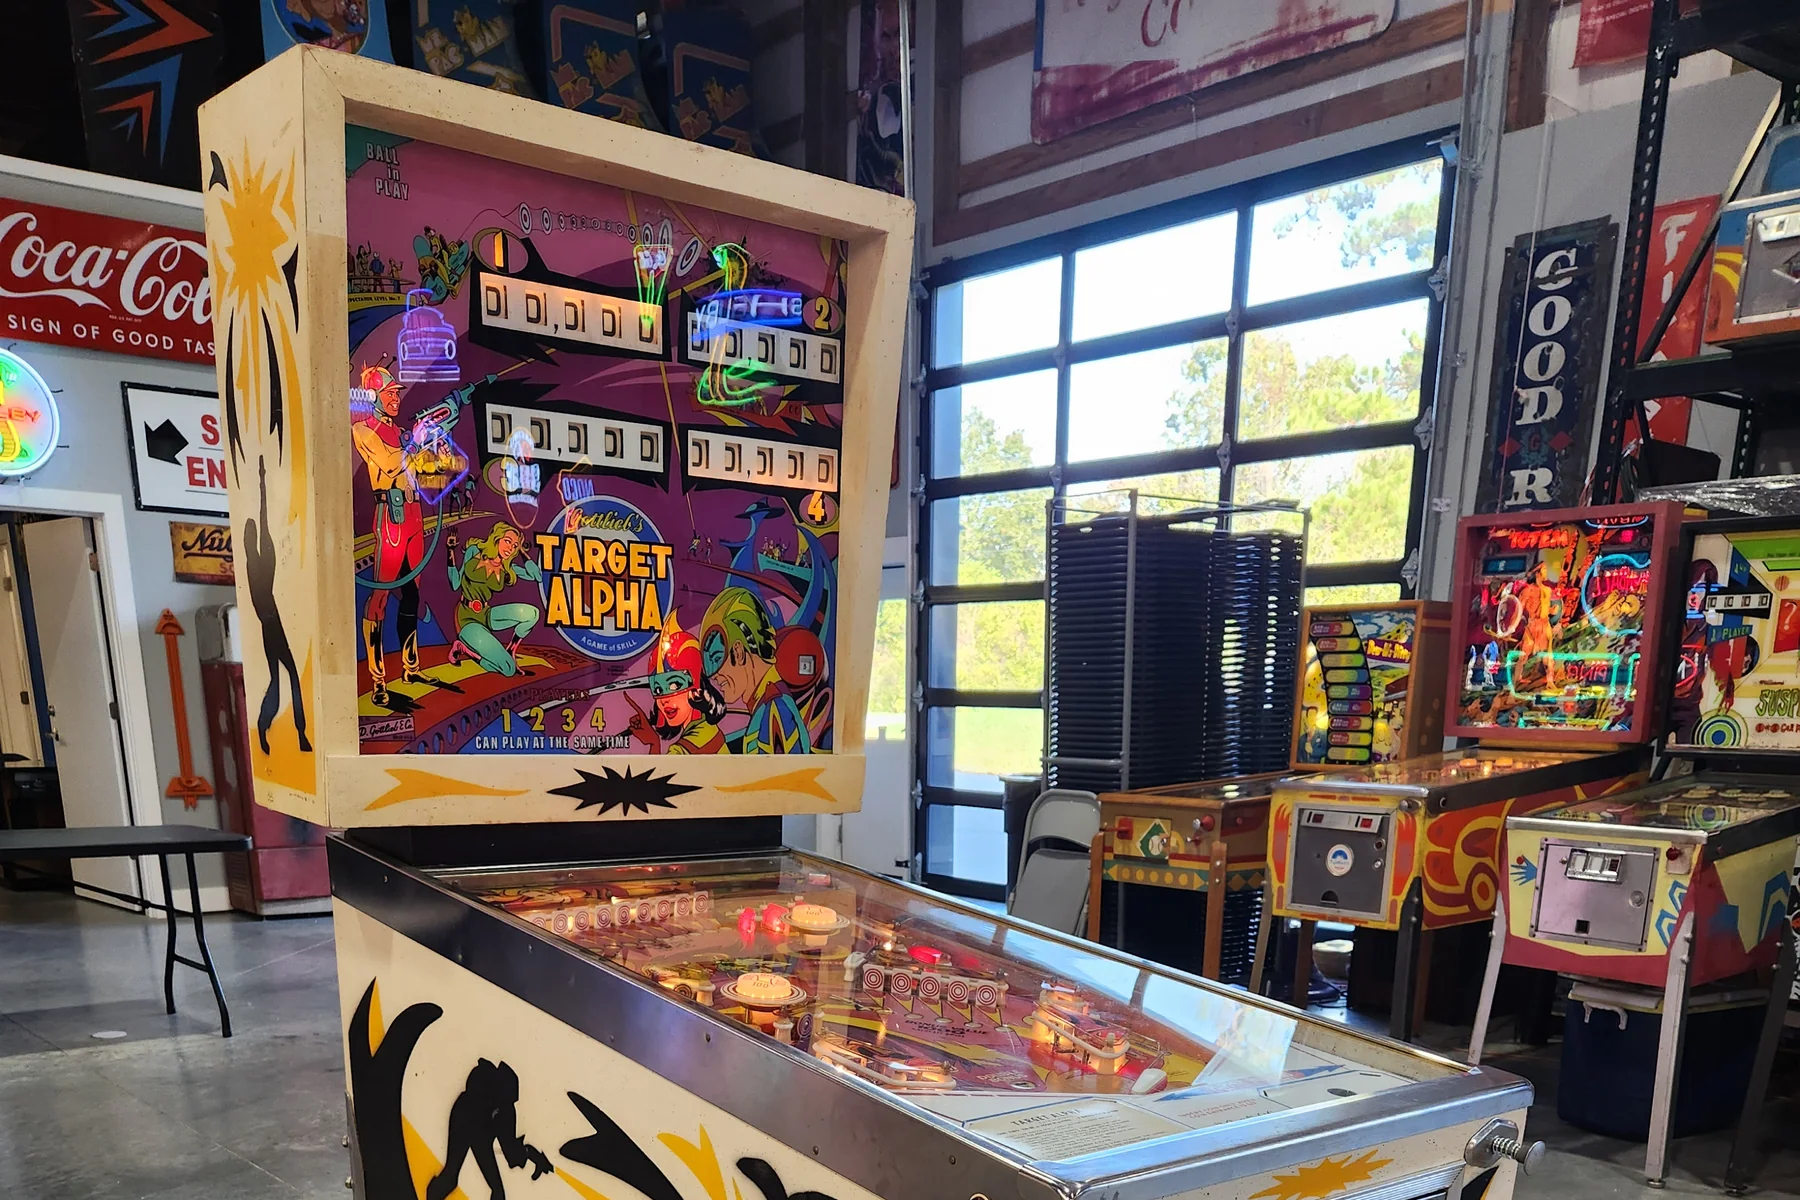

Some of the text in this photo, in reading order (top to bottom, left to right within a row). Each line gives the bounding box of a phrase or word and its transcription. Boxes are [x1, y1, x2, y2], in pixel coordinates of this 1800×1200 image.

[366, 142, 399, 165] BALL
[387, 165, 400, 181] in
[375, 178, 409, 200] PLAY
[815, 297, 832, 331] 2
[8, 314, 61, 335] SIGN
[73, 324, 100, 339] OF
[113, 329, 174, 350] GOOD
[1515, 248, 1577, 425] GOOD
[0, 407, 41, 423] EY
[201, 414, 222, 446] S
[807, 491, 825, 523] 4
[569, 508, 644, 532] Gottlieb's
[1509, 528, 1569, 549] TOTEM
[535, 533, 673, 580] TARGET
[547, 576, 663, 631] ALPHA
[587, 638, 607, 651] GAME
[609, 643, 616, 651] of
[617, 639, 638, 651] SKILL
[530, 688, 591, 701] PLAYERS
[1755, 688, 1800, 718] SUSP
[370, 720, 398, 737] Gottlieb
[502, 707, 606, 733] 1 2 3 4
[475, 736, 630, 749] CAN PLAY AT THE SAME TIME
